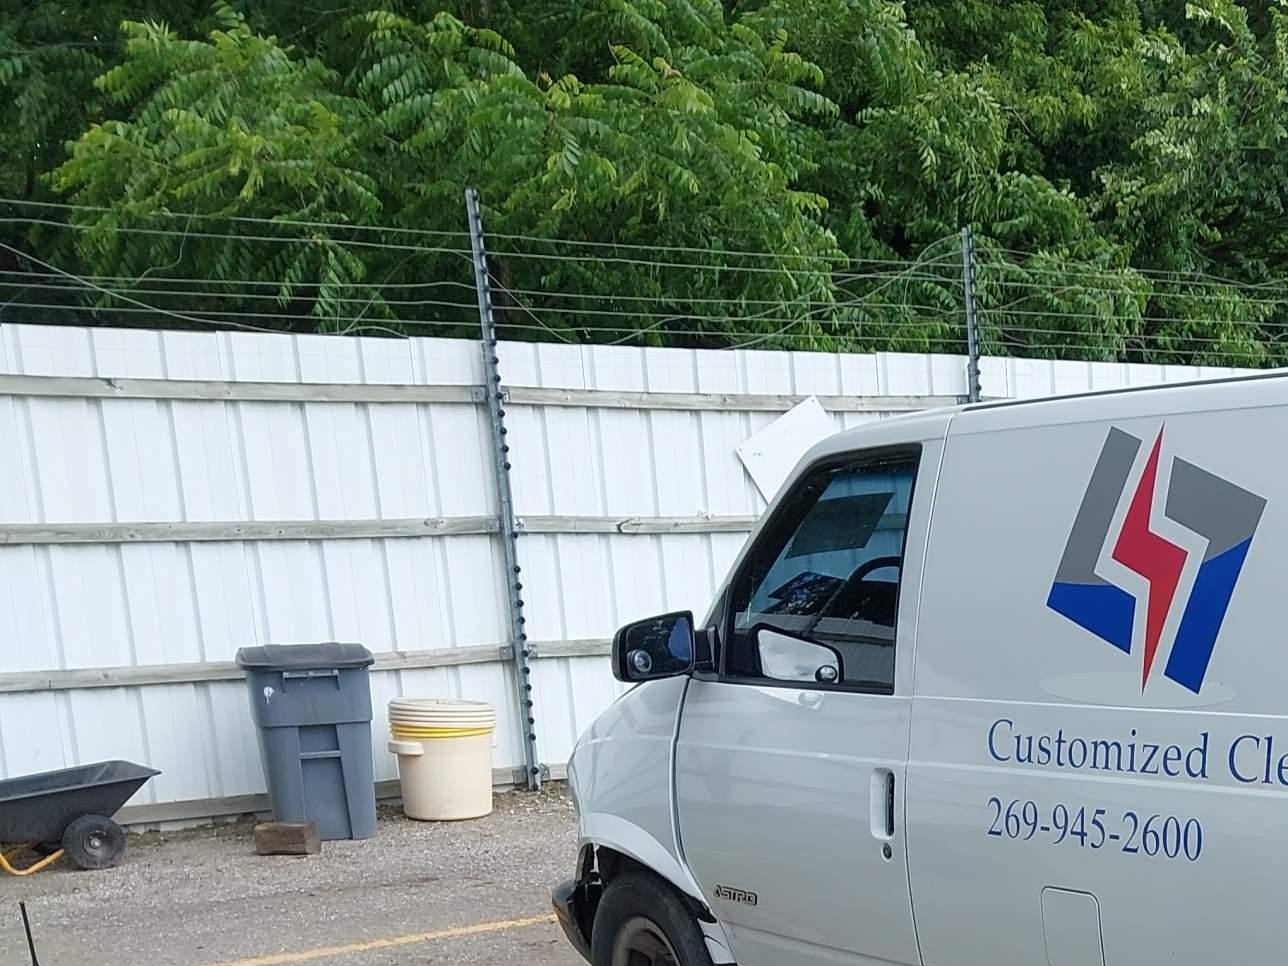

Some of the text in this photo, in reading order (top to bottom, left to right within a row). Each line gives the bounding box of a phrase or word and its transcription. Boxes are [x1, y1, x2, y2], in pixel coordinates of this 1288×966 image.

[987, 717, 1209, 780] Customized
[987, 796, 1203, 863] 269-945-2600
[713, 884, 758, 906] ASTRO
